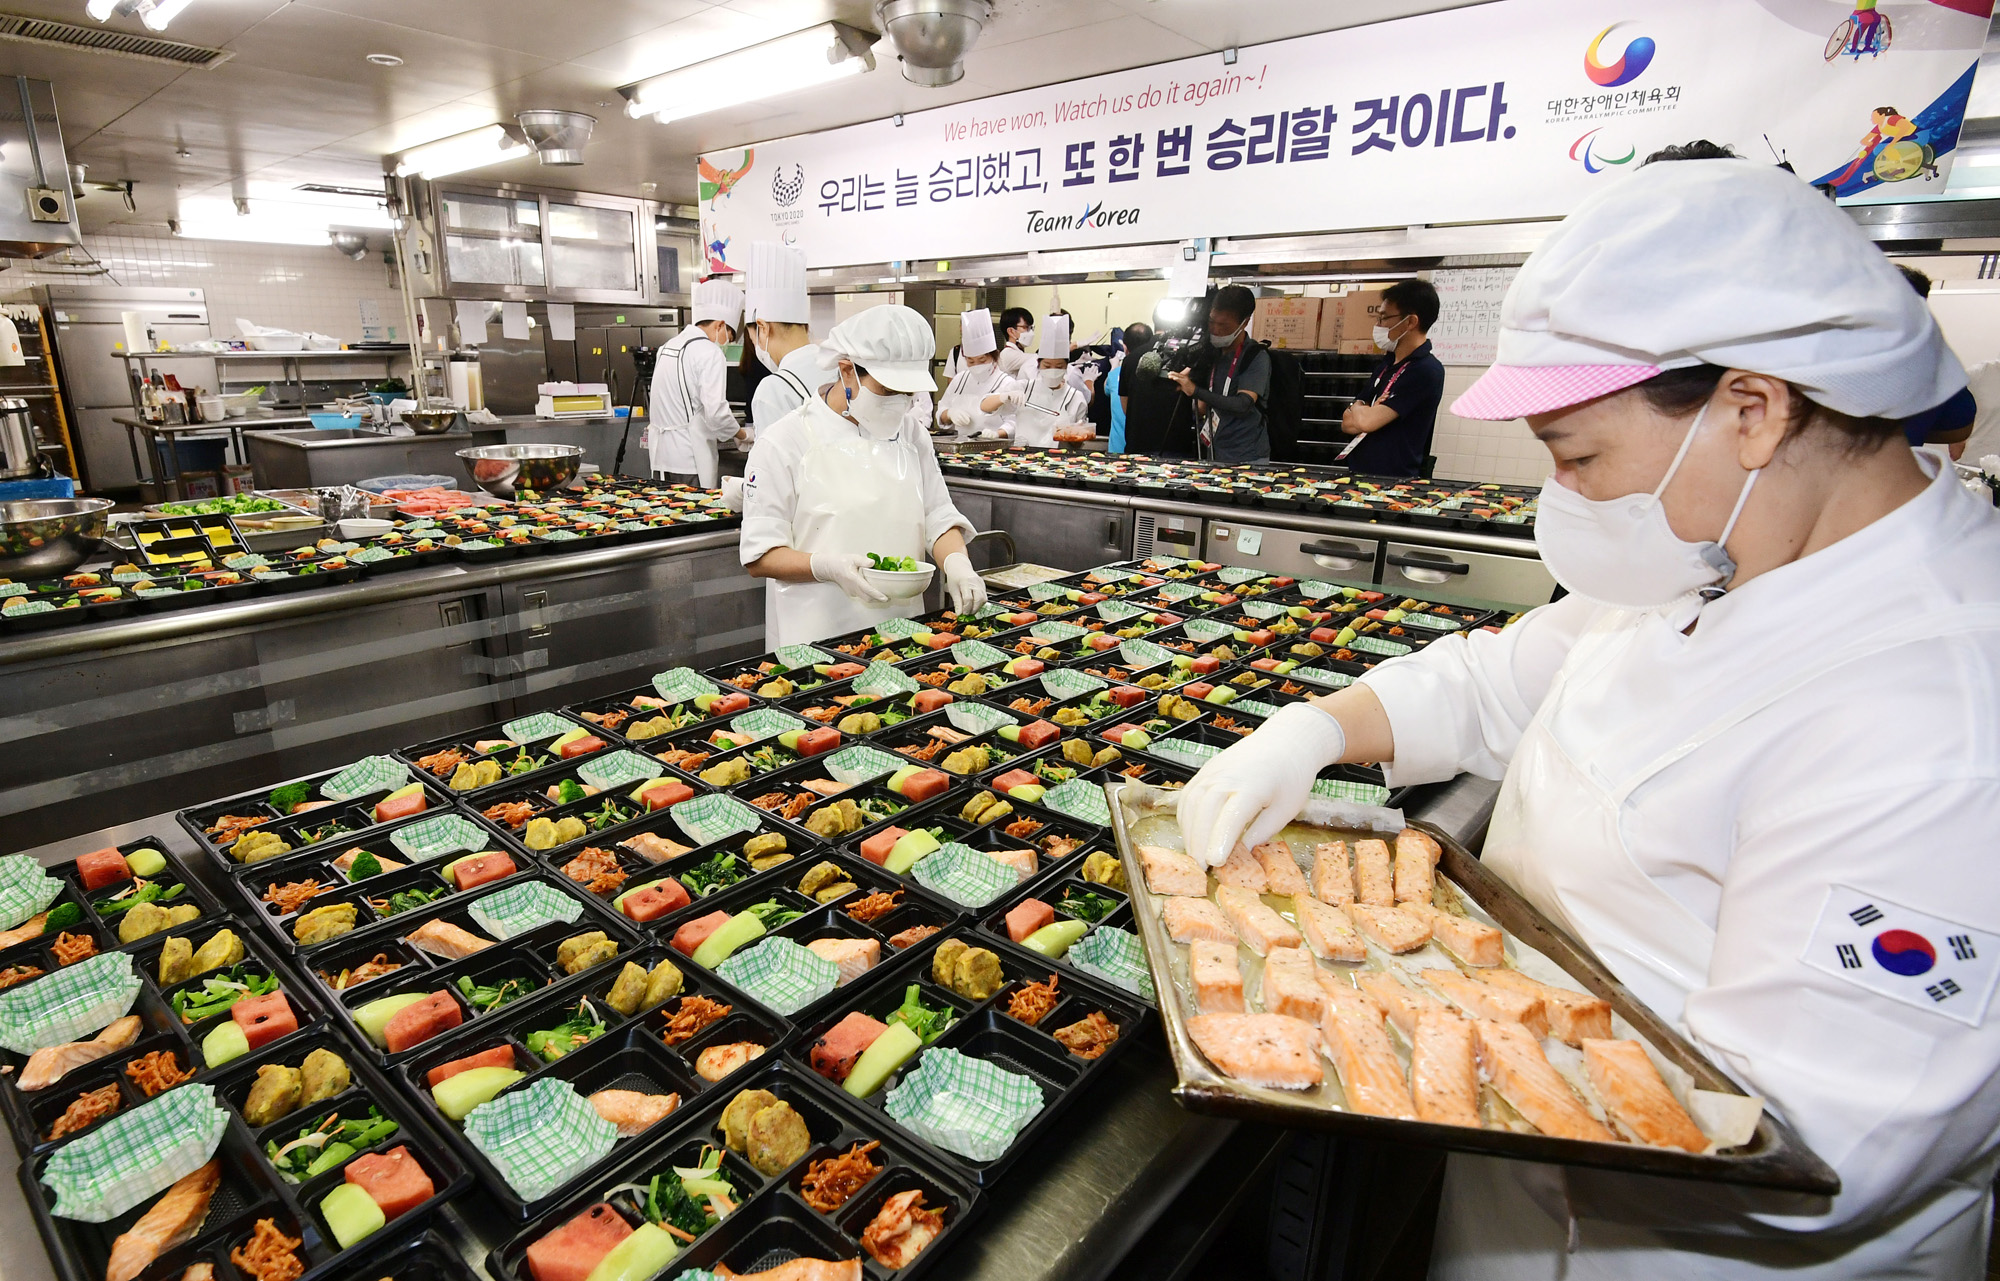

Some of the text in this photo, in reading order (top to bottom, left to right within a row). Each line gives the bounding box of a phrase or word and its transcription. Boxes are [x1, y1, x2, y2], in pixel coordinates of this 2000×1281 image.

[945, 122, 967, 142] We
[970, 115, 1007, 138] have
[1011, 109, 1048, 131] won,
[1055, 94, 1108, 123] Watch
[1112, 93, 1134, 114] us
[1137, 84, 1163, 109] do
[1166, 81, 1181, 104] it
[1545, 104, 1678, 124] KOREA PARALYMPIC COMMITTEE
[1547, 86, 1681, 116] 대한장애인체육회
[818, 81, 1518, 217] 우리는 늘 승리했고, 또 한 번 승리할 것이다.
[770, 210, 803, 221] TOKYO 2020
[1026, 199, 1141, 234] Team Korea
